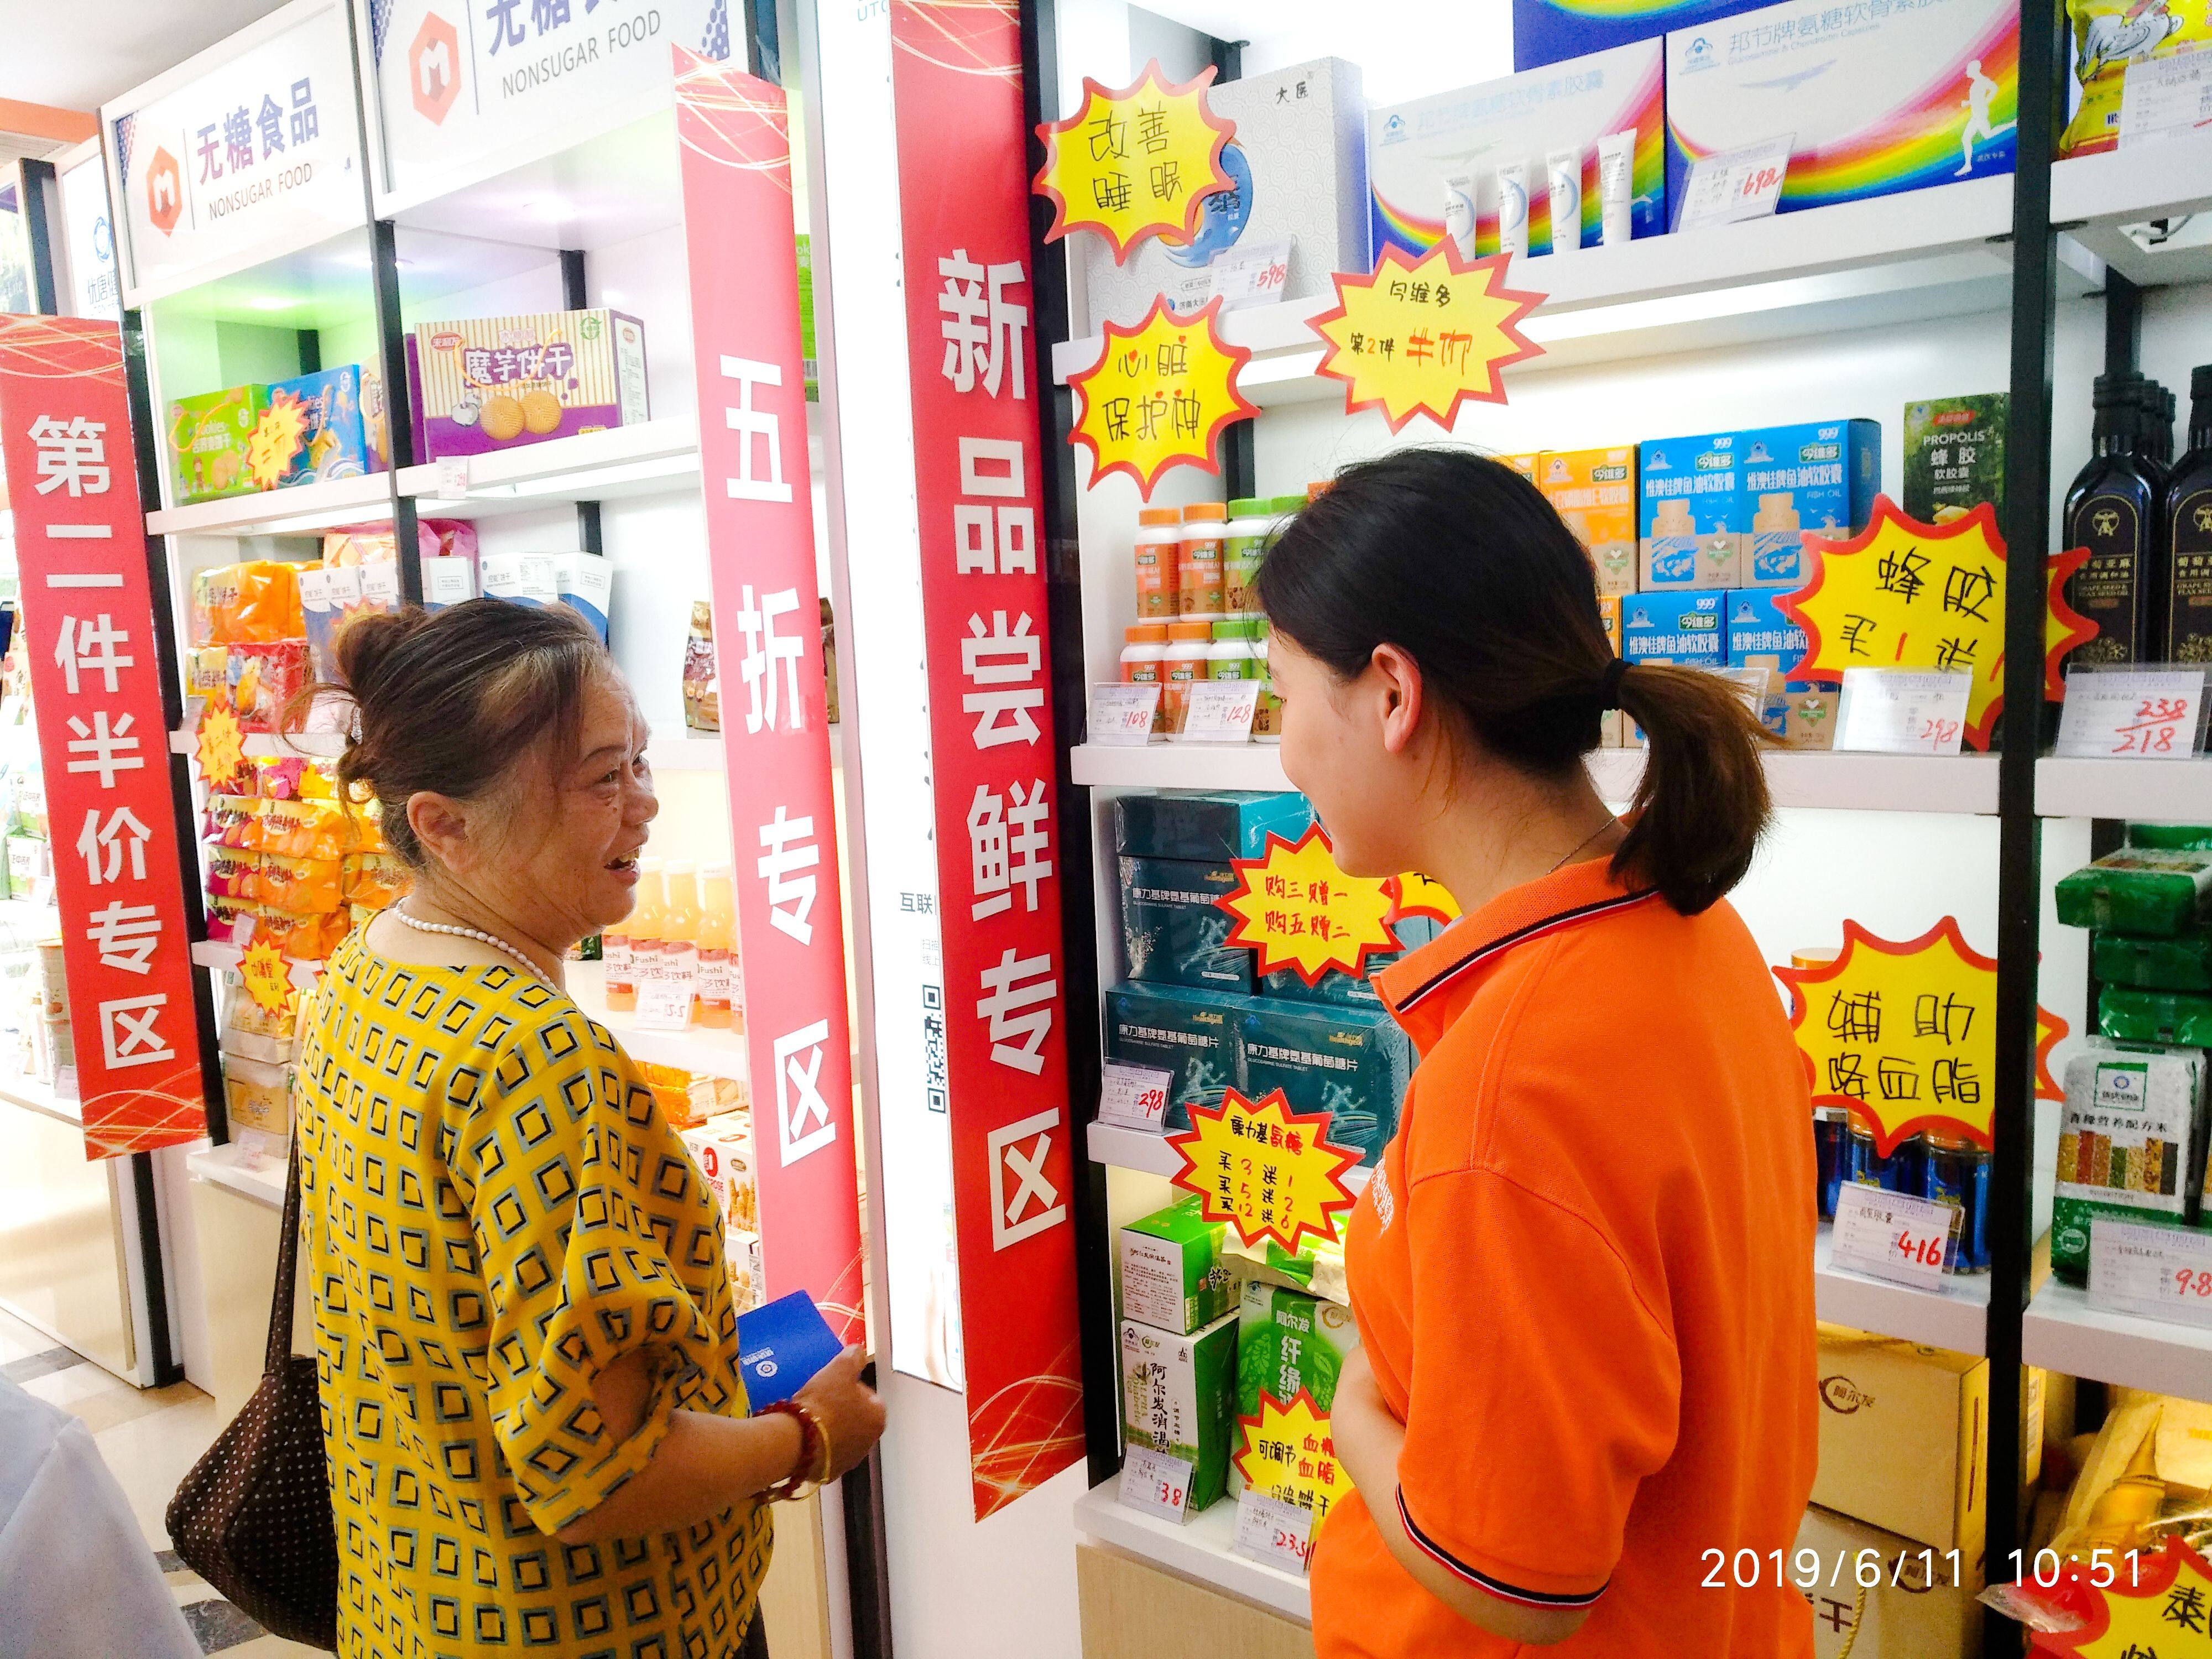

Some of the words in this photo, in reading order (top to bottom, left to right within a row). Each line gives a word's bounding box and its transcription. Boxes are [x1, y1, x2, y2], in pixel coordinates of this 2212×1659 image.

[502, 37, 599, 98] NONSUGAR
[609, 10, 660, 53] FOOD
[197, 77, 319, 186] 无糖食品
[1088, 100, 1167, 161] 改善
[210, 179, 273, 220] NONSUGAR
[278, 163, 312, 192] FOOD
[1093, 161, 1183, 212] 睡眠
[1743, 168, 1777, 195] 698
[1258, 263, 1286, 289] 598
[466, 347, 571, 386] 魔芋饼干
[1118, 335, 1188, 378] 心脏
[1103, 388, 1201, 441] 保护神
[1713, 437, 1732, 449] 999
[1817, 427, 1839, 440] 999
[1923, 430, 1985, 446] PROPOLIS
[1931, 446, 1976, 466] 蜂胶
[1935, 467, 1969, 480] 软胶囊
[1875, 546, 1997, 623] 蜂胶
[1696, 598, 1715, 610] 999
[1126, 711, 1148, 728] 108
[1227, 705, 1251, 723] 128
[28, 415, 175, 1070] 第二件半价专区
[1921, 719, 1959, 751] 298
[2112, 726, 2176, 754] 218
[719, 354, 836, 1168] 五折专区
[938, 248, 1066, 1253] 新品尝鲜专区
[900, 892, 937, 915] 互联
[1265, 875, 1348, 906] 购三赠一
[1265, 910, 1350, 941] 购五赠二
[701, 966, 723, 974] Fushi
[1827, 989, 1976, 1045] 辅助
[1119, 1024, 1219, 1048] 康力基牌氨基葡萄糖片
[1247, 1043, 1359, 1072] 康力基牌氨基葡萄糖片
[1138, 1089, 1164, 1118] 298
[1898, 1230, 1941, 1266] 416
[1276, 1310, 1310, 1333] 阿尔发
[1150, 1363, 1170, 1454] 阿尔发消渴
[1833, 1385, 1875, 1408] 阿尔发
[1259, 1439, 1296, 1467] 可调节
[1298, 1460, 1335, 1486] 血脂
[1161, 1482, 1182, 1506] 38
[2162, 1583, 2212, 1639] 泰
